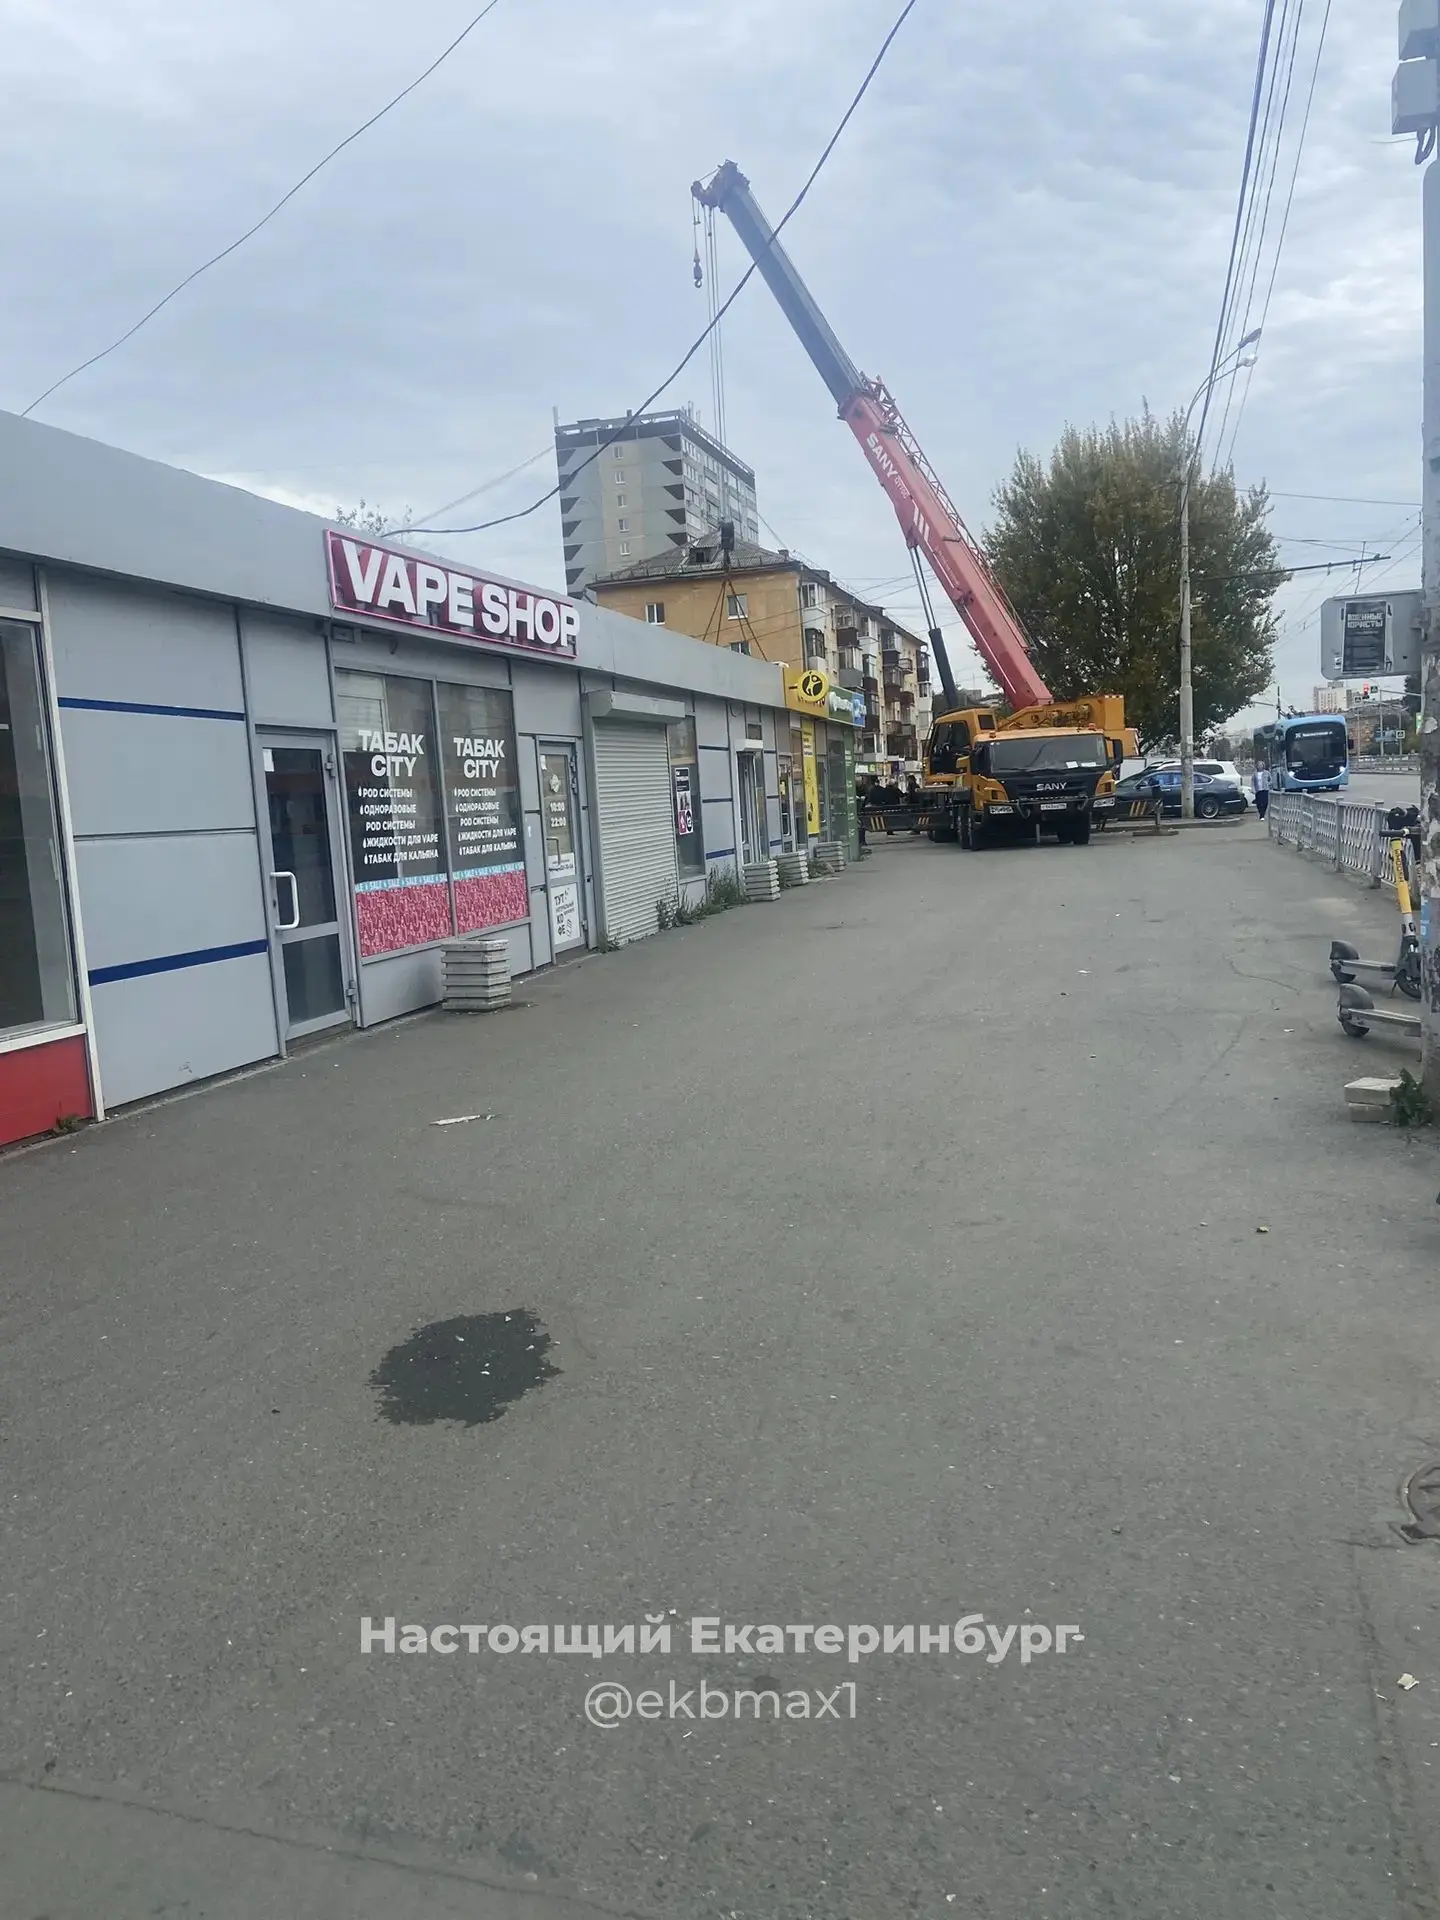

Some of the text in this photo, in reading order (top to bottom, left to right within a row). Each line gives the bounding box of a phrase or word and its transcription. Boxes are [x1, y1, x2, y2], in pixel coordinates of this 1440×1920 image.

[866, 432, 898, 479] SANY
[341, 539, 581, 648] VAPE SHOP
[358, 729, 425, 755] ТАБАК
[453, 737, 505, 758] ТАБАК
[370, 754, 418, 777] CITY
[463, 759, 500, 779] CITY
[363, 788, 413, 798] POD СИСТЕМЫ
[470, 787, 496, 797] СИСТЕМЫ
[1036, 782, 1067, 791] SANY
[364, 804, 417, 816] ОДНОРАЗОВЫЕ
[459, 802, 499, 813] ОДНОРАЗОВЫЕ
[366, 820, 416, 831] POD СИСТЕМЫ
[473, 816, 499, 826] СИСТЕМЫ
[367, 834, 439, 848] ЖИДКОСТИ ДЛЯ VAPE
[460, 827, 517, 841] ЖИДКОСТИ ДЛЯ VAPE
[461, 841, 517, 856] ТАБАК ДЛЯ КАЛЬЯНА
[369, 849, 439, 864] ТАБАК ДЛЯ КАЛЬЯНА
